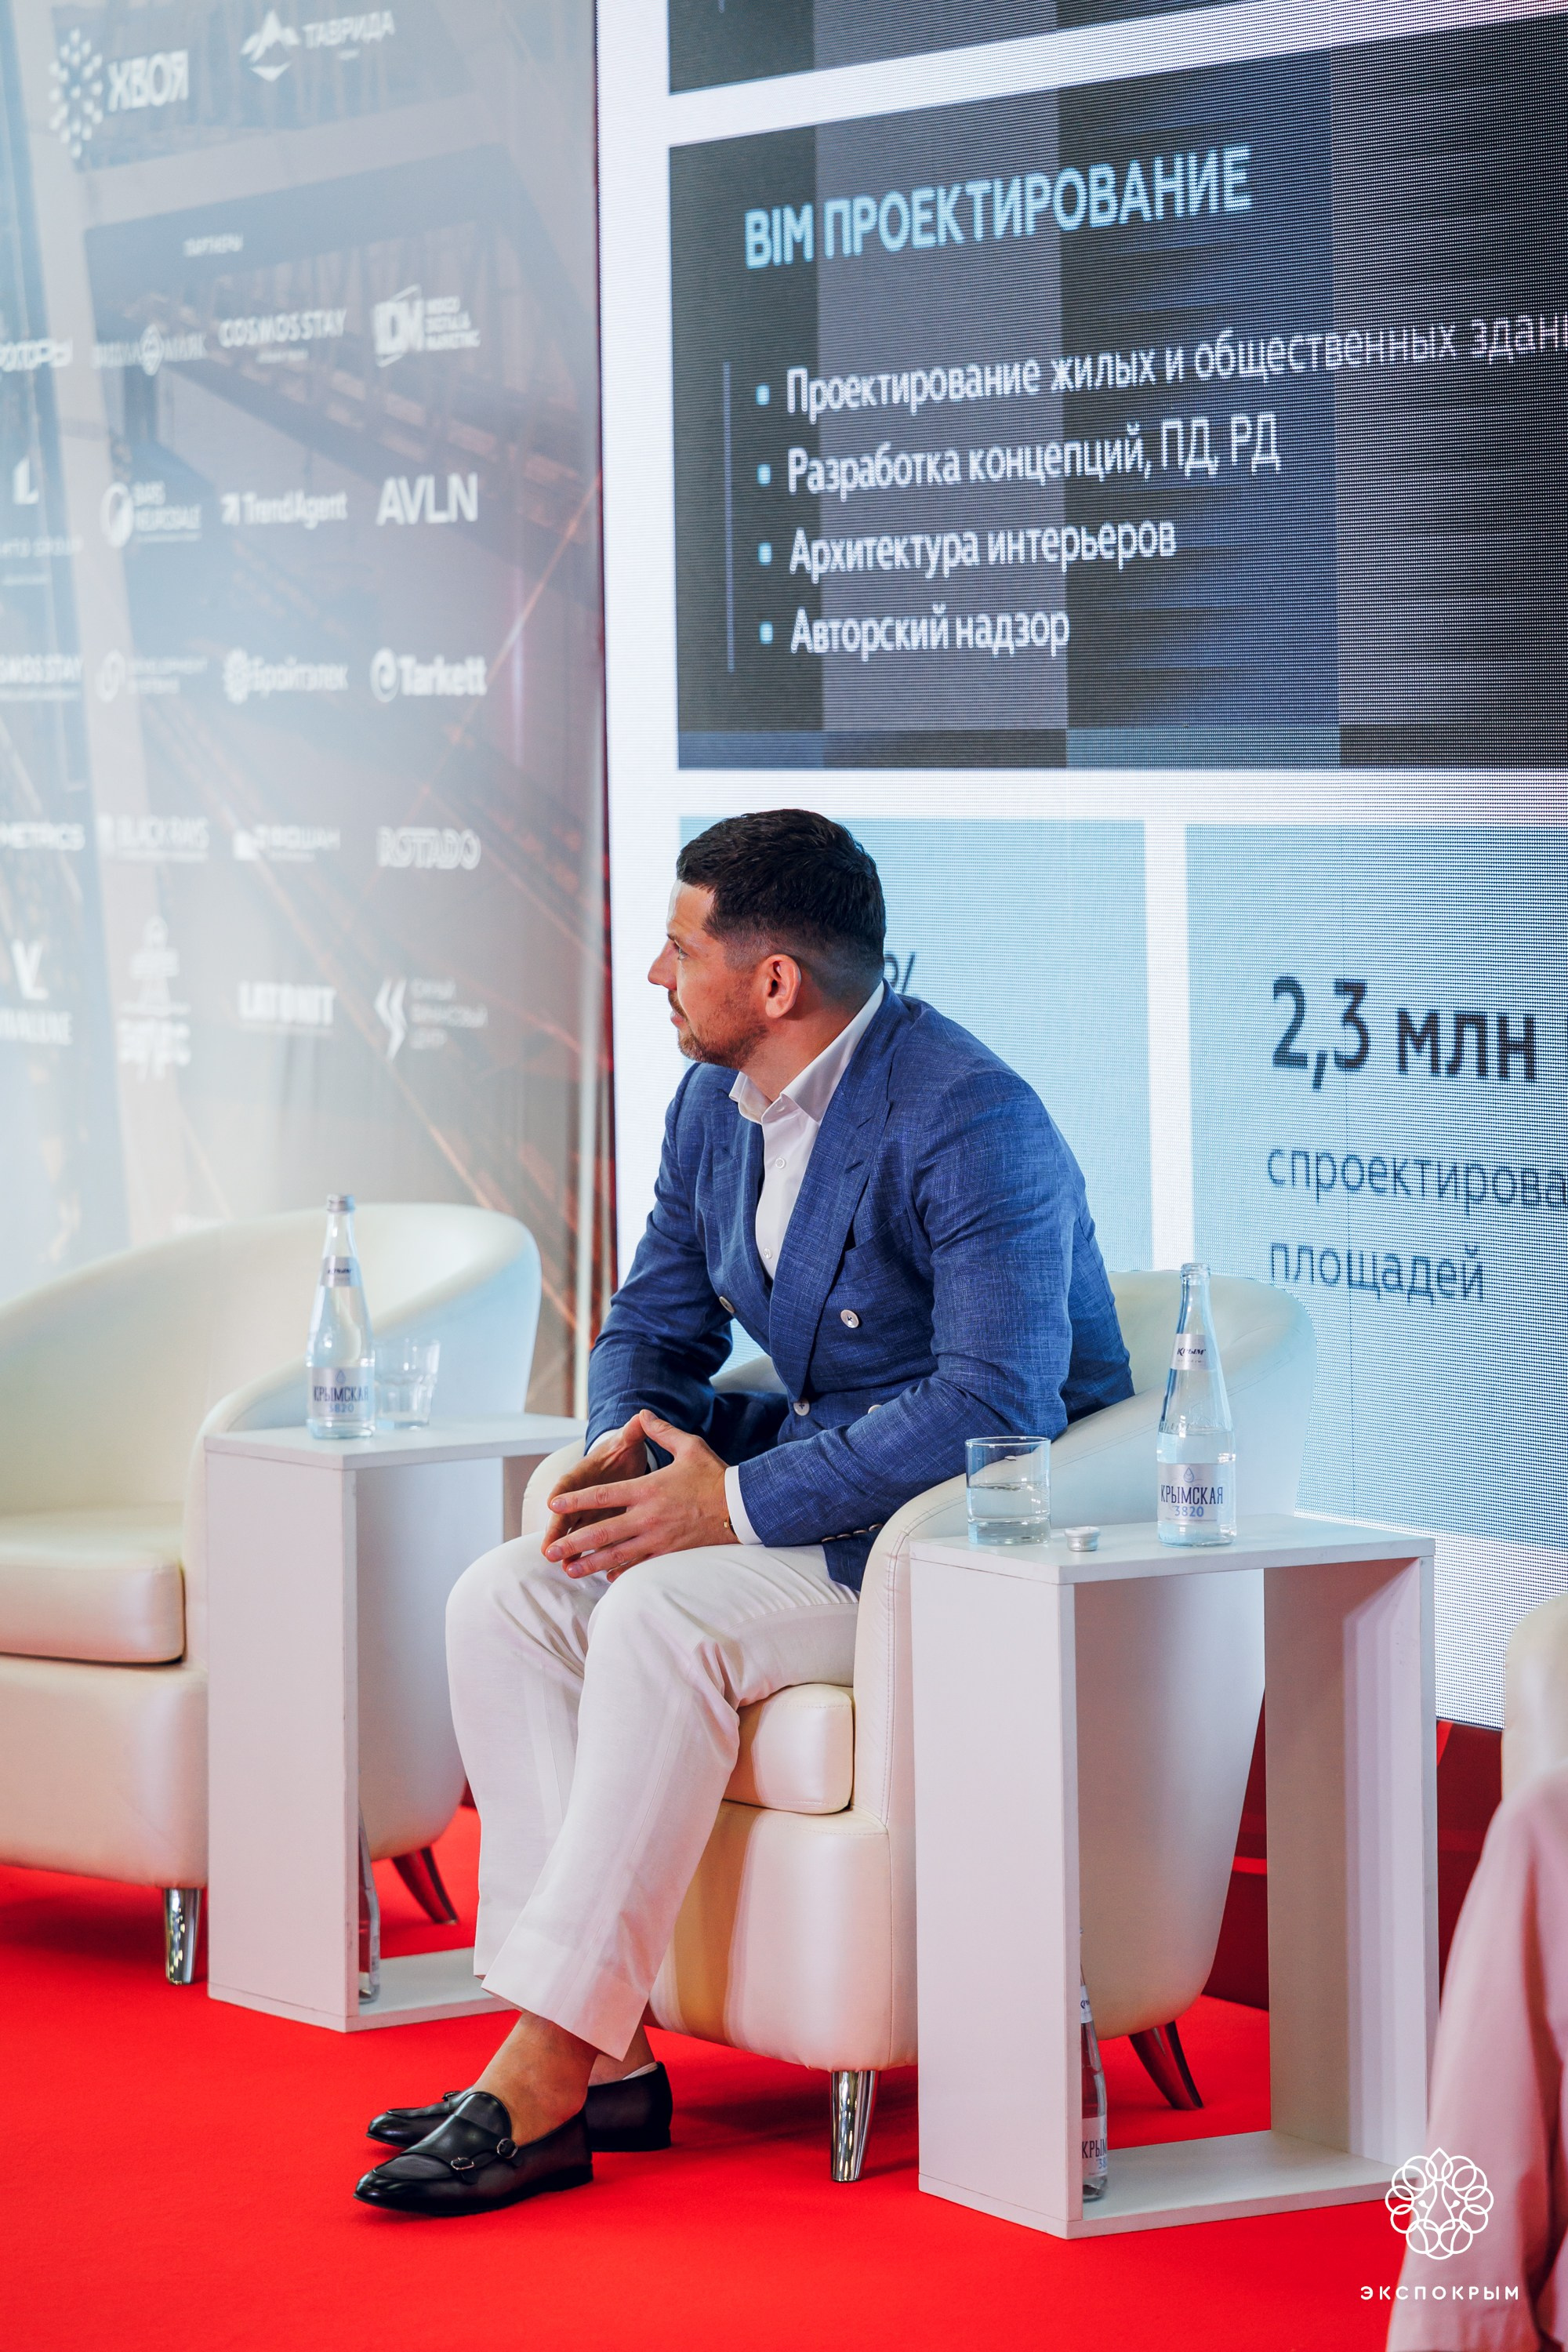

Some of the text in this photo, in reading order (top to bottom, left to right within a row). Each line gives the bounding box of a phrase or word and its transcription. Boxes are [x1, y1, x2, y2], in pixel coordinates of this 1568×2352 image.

[302, 9, 396, 49] ТАВРИДА
[107, 49, 189, 112] ХВОЯ
[744, 143, 1253, 269] BIM ПРОЕКТИРОВАНИЕ
[786, 357, 1040, 424] Проектирование
[1051, 348, 1156, 393] жилых
[1165, 346, 1185, 384] и
[1194, 324, 1457, 383] общественных
[786, 441, 962, 503] Разработка
[969, 421, 1152, 488] концепций,
[1231, 411, 1282, 476] РД
[241, 488, 348, 529] TrendAgent
[376, 473, 478, 526] AVLN
[789, 517, 1176, 585] Архитектура интерьеров
[790, 603, 1070, 662] Авторский надзор
[398, 655, 488, 696] Tarkett
[1272, 975, 1537, 1091] 2,3 млн
[1268, 1148, 1568, 1216] спроектирова
[1269, 1242, 1484, 1306] площадей
[1160, 1484, 1224, 1504] КРЫМСКАЯ
[1172, 1505, 1205, 1518] 3820
